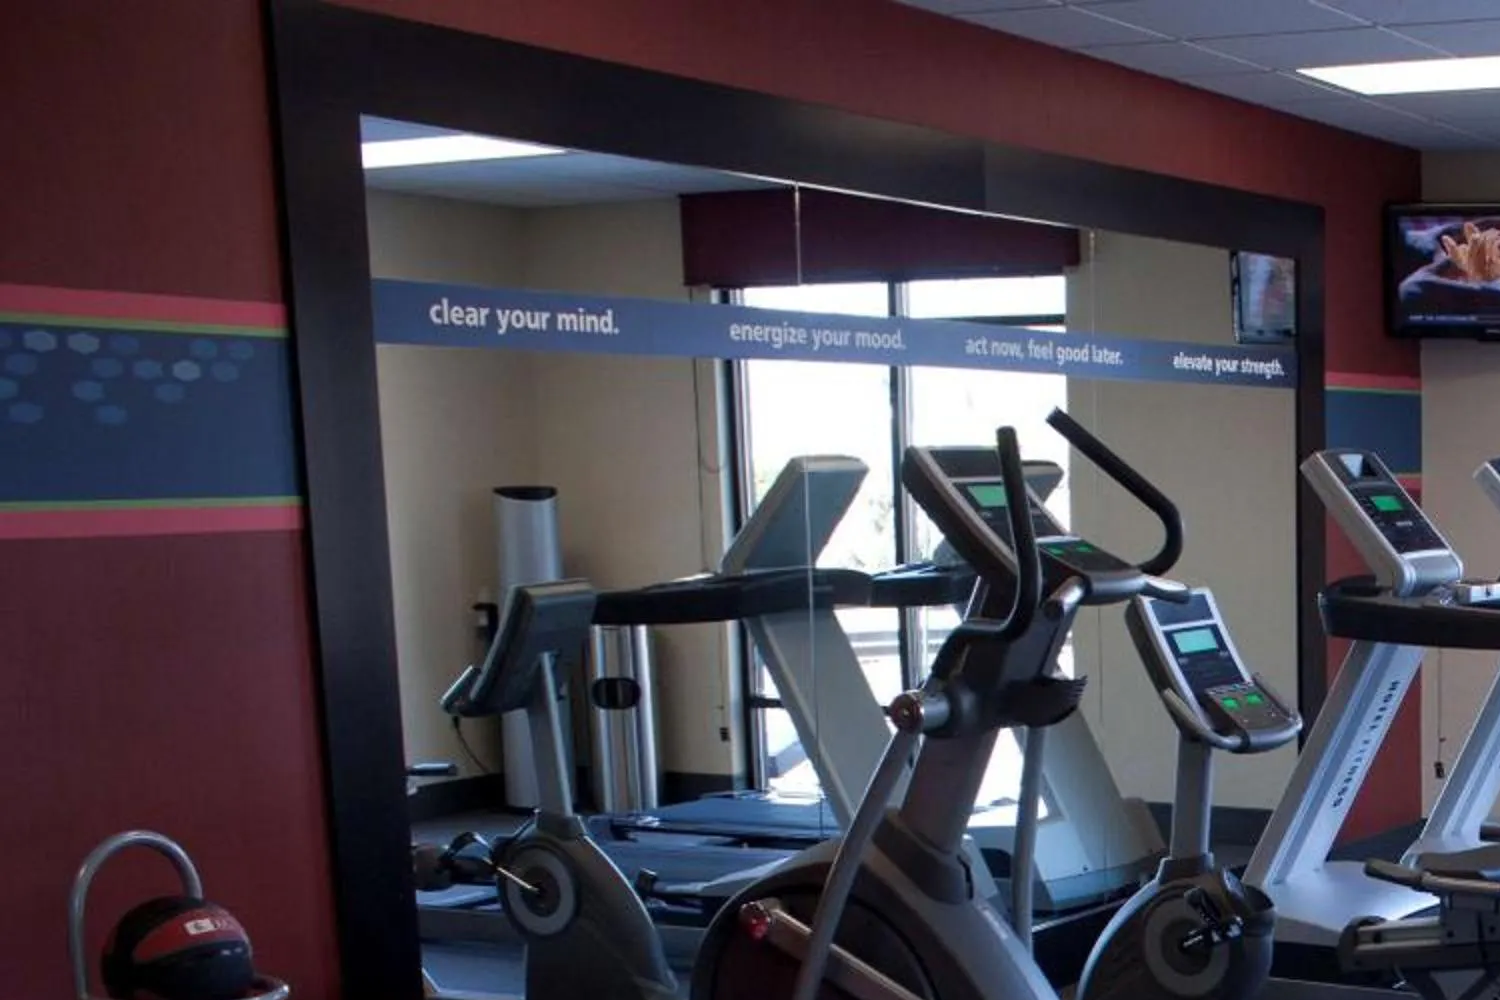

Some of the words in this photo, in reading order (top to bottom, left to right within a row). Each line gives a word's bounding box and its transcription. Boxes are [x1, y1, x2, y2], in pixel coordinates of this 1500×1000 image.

[429, 297, 490, 327] clear
[496, 308, 551, 335] your
[556, 307, 620, 334] mind.
[729, 321, 808, 349] energize
[812, 328, 852, 351] your
[855, 328, 906, 350] mood.
[965, 336, 989, 356] act
[991, 341, 1024, 360] now,
[1027, 338, 1053, 360] feel
[1056, 343, 1089, 366] good
[1091, 344, 1124, 365] later.
[1173, 351, 1213, 372] elevate
[1215, 358, 1239, 377] your
